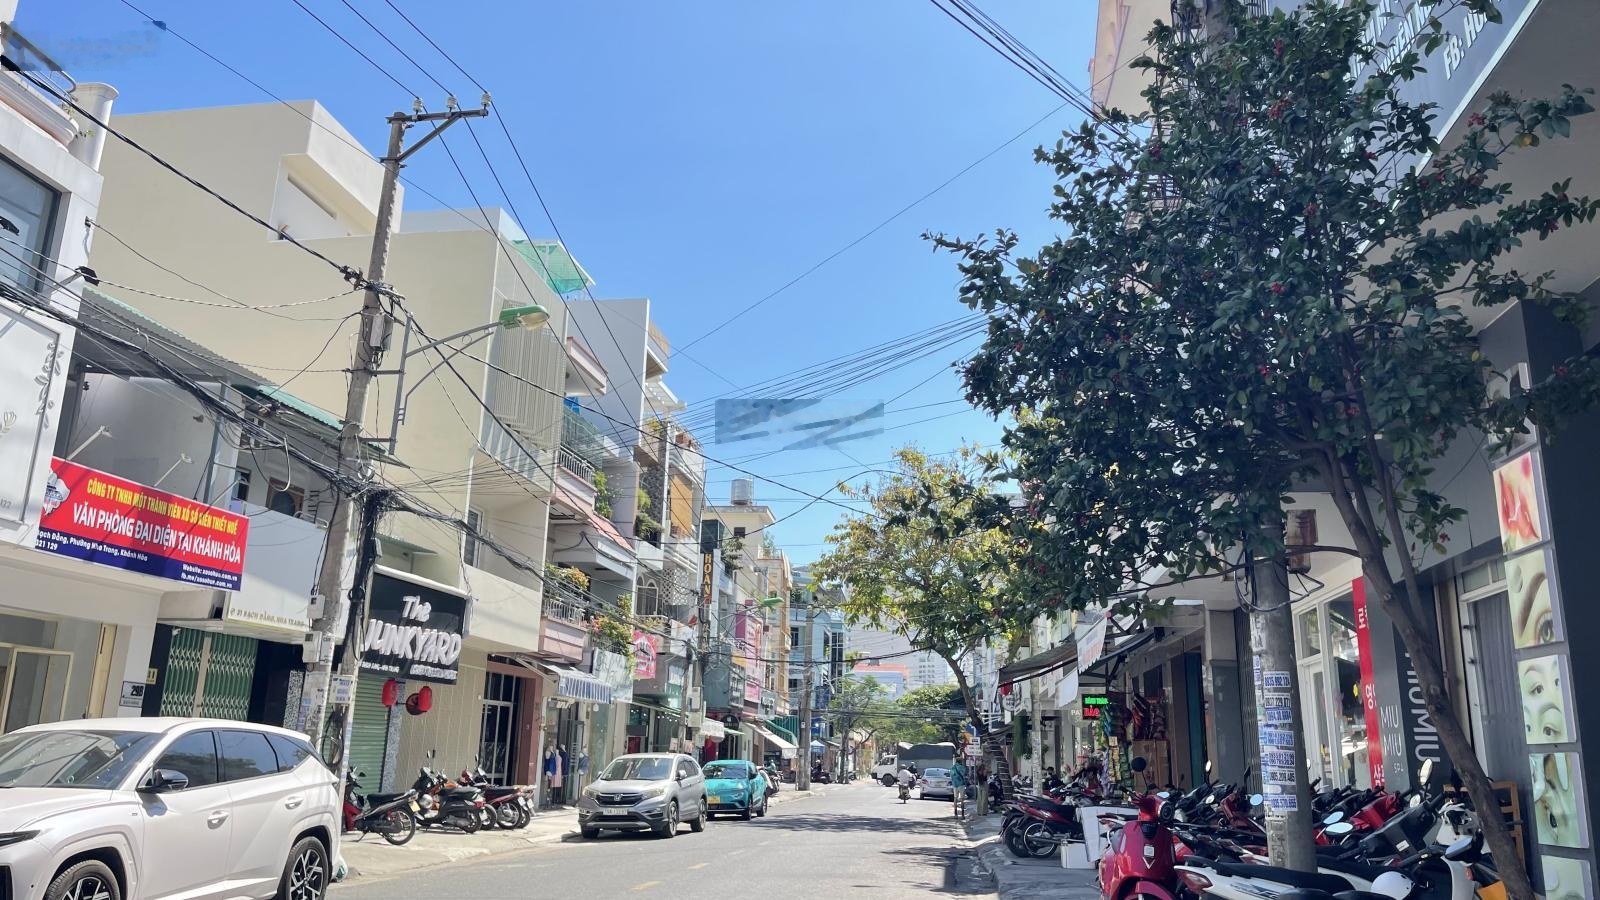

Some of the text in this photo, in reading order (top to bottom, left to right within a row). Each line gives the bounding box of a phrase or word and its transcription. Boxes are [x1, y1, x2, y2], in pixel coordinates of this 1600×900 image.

[1444, 35, 1465, 80] FB:
[87, 478, 106, 497] CÔNG
[107, 486, 116, 500] TY
[116, 488, 132, 506] TNHH
[74, 500, 241, 564] VĂN PHÒNG ĐẠI DIỆN TẠI KHÁNH HÒA
[47, 542, 58, 551] 129
[402, 596, 432, 622] The
[360, 619, 462, 666] JUNKYARD
[130, 685, 144, 696] 29B
[1380, 704, 1399, 728] MIU
[1384, 733, 1402, 757] MIU
